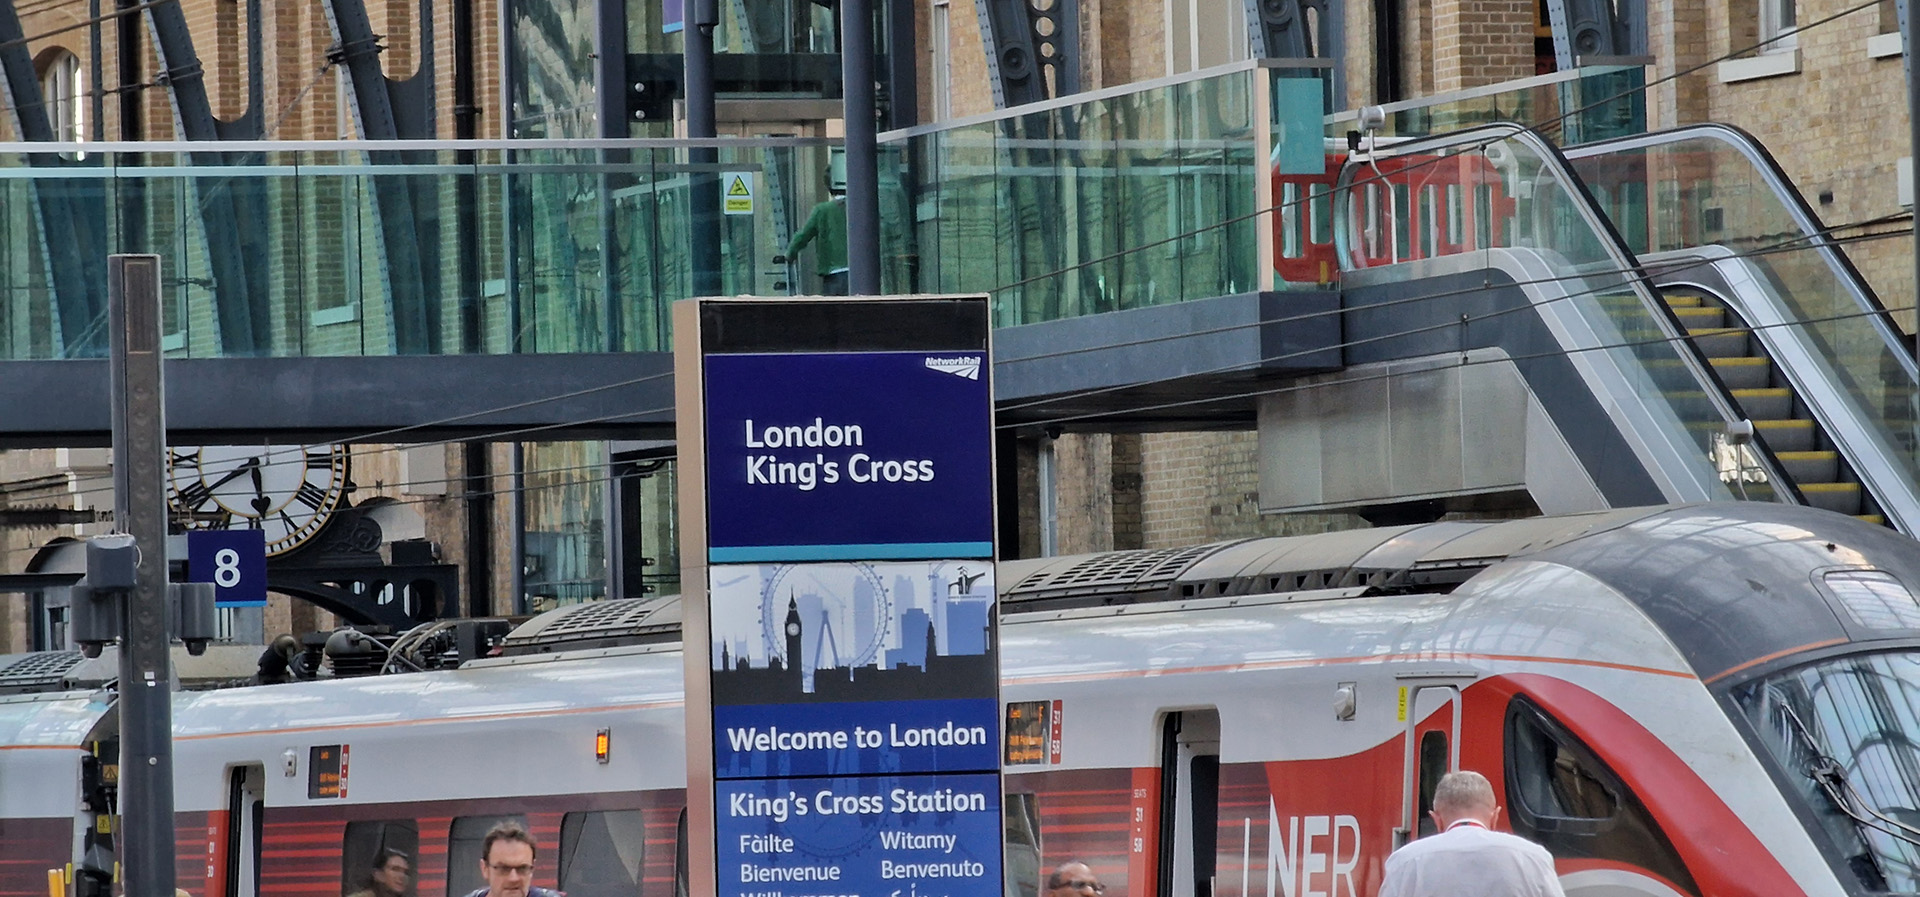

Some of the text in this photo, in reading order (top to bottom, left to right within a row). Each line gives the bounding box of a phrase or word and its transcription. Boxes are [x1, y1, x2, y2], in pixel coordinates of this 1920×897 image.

[745, 417, 863, 448] London
[747, 453, 935, 491] King's Cross
[214, 548, 241, 588] 8
[727, 726, 848, 752] Welcome
[854, 726, 883, 748] to
[890, 721, 986, 747] London
[815, 790, 884, 815] Cross
[891, 788, 986, 813] Station
[740, 834, 794, 853] Fàilte
[880, 831, 957, 853] Witamy
[740, 863, 841, 883] Bienvenue
[881, 859, 985, 879] Benvenuto
